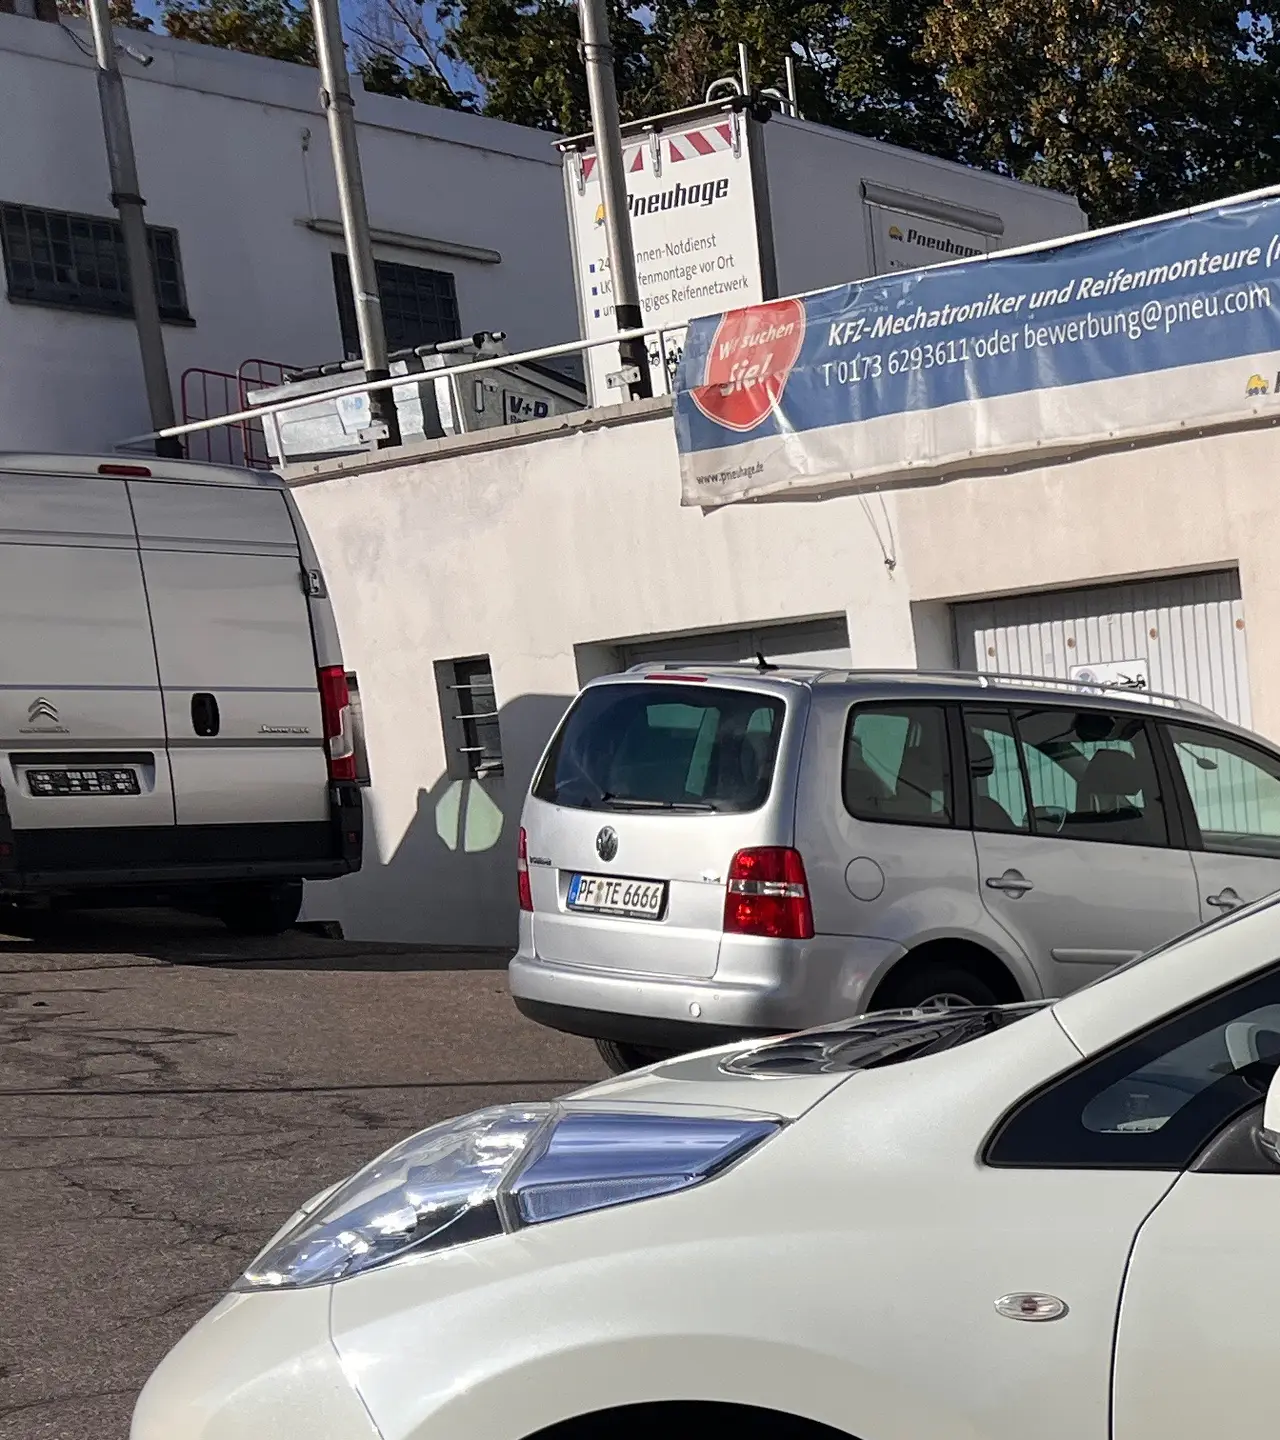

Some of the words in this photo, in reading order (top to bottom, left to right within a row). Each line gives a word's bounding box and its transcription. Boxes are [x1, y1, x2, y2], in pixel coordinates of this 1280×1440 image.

[635, 233, 717, 264] nnen-Notdienst
[637, 265, 697, 287] fenmontage
[699, 260, 715, 273] vor
[717, 254, 735, 270] Ort
[639, 295, 670, 314] ngiges
[671, 275, 749, 304] Reifennetzwerk
[828, 293, 1026, 347] KFZ-Mechatroniker
[1028, 277, 1073, 310] und
[1076, 244, 1262, 300] Reifenmonteure
[741, 321, 795, 348] suchen
[822, 361, 836, 388] T
[837, 352, 883, 384] 0173
[888, 337, 970, 376] 6293611
[974, 328, 1017, 358] oder
[1024, 285, 1272, 350] bewerbung@pneu.com
[510, 396, 549, 418] V+D
[578, 879, 597, 902] PF
[604, 881, 622, 905] TE
[623, 883, 660, 910] 6666
